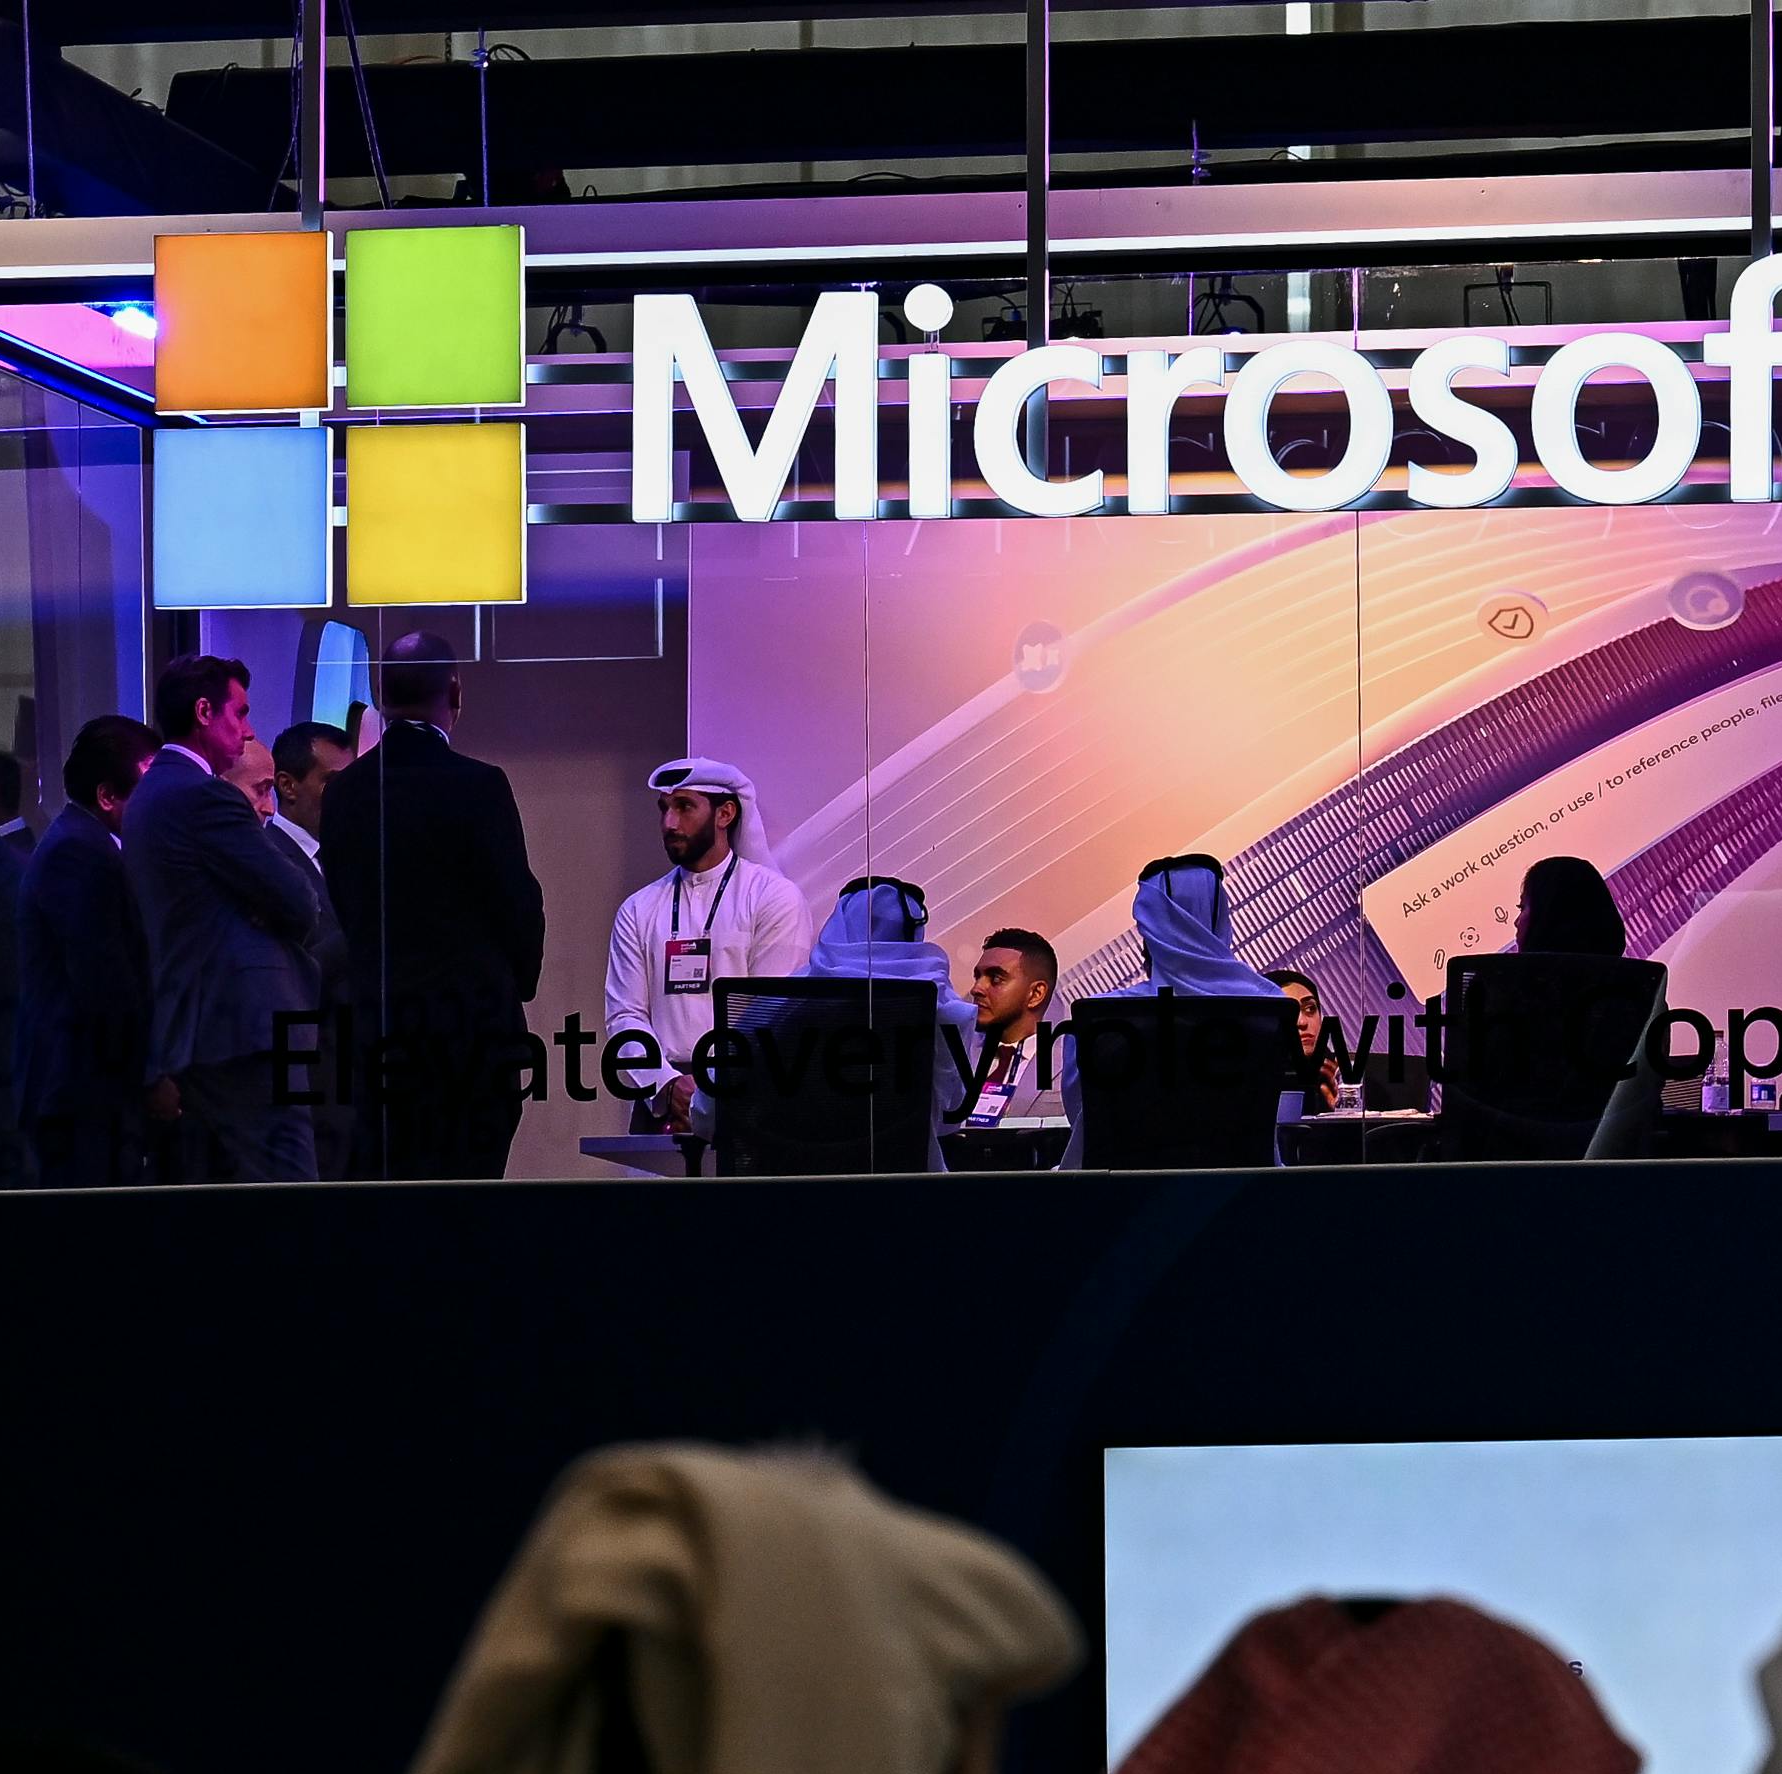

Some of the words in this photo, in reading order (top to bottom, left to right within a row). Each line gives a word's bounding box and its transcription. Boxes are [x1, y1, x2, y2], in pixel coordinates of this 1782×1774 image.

[1402, 892, 1431, 918] Ask
[1431, 886, 1442, 899] a
[1440, 860, 1481, 892] work
[1480, 820, 1549, 868] question,
[1549, 806, 1566, 824] or
[1568, 790, 1595, 813] use
[1605, 774, 1624, 790] to
[1625, 732, 1700, 779] reference
[1701, 705, 1761, 742] people,
[273, 1003, 662, 1105] Elevate
[693, 1021, 1001, 1124] every
[1036, 986, 1248, 1091] role
[1275, 980, 1530, 1084] with
